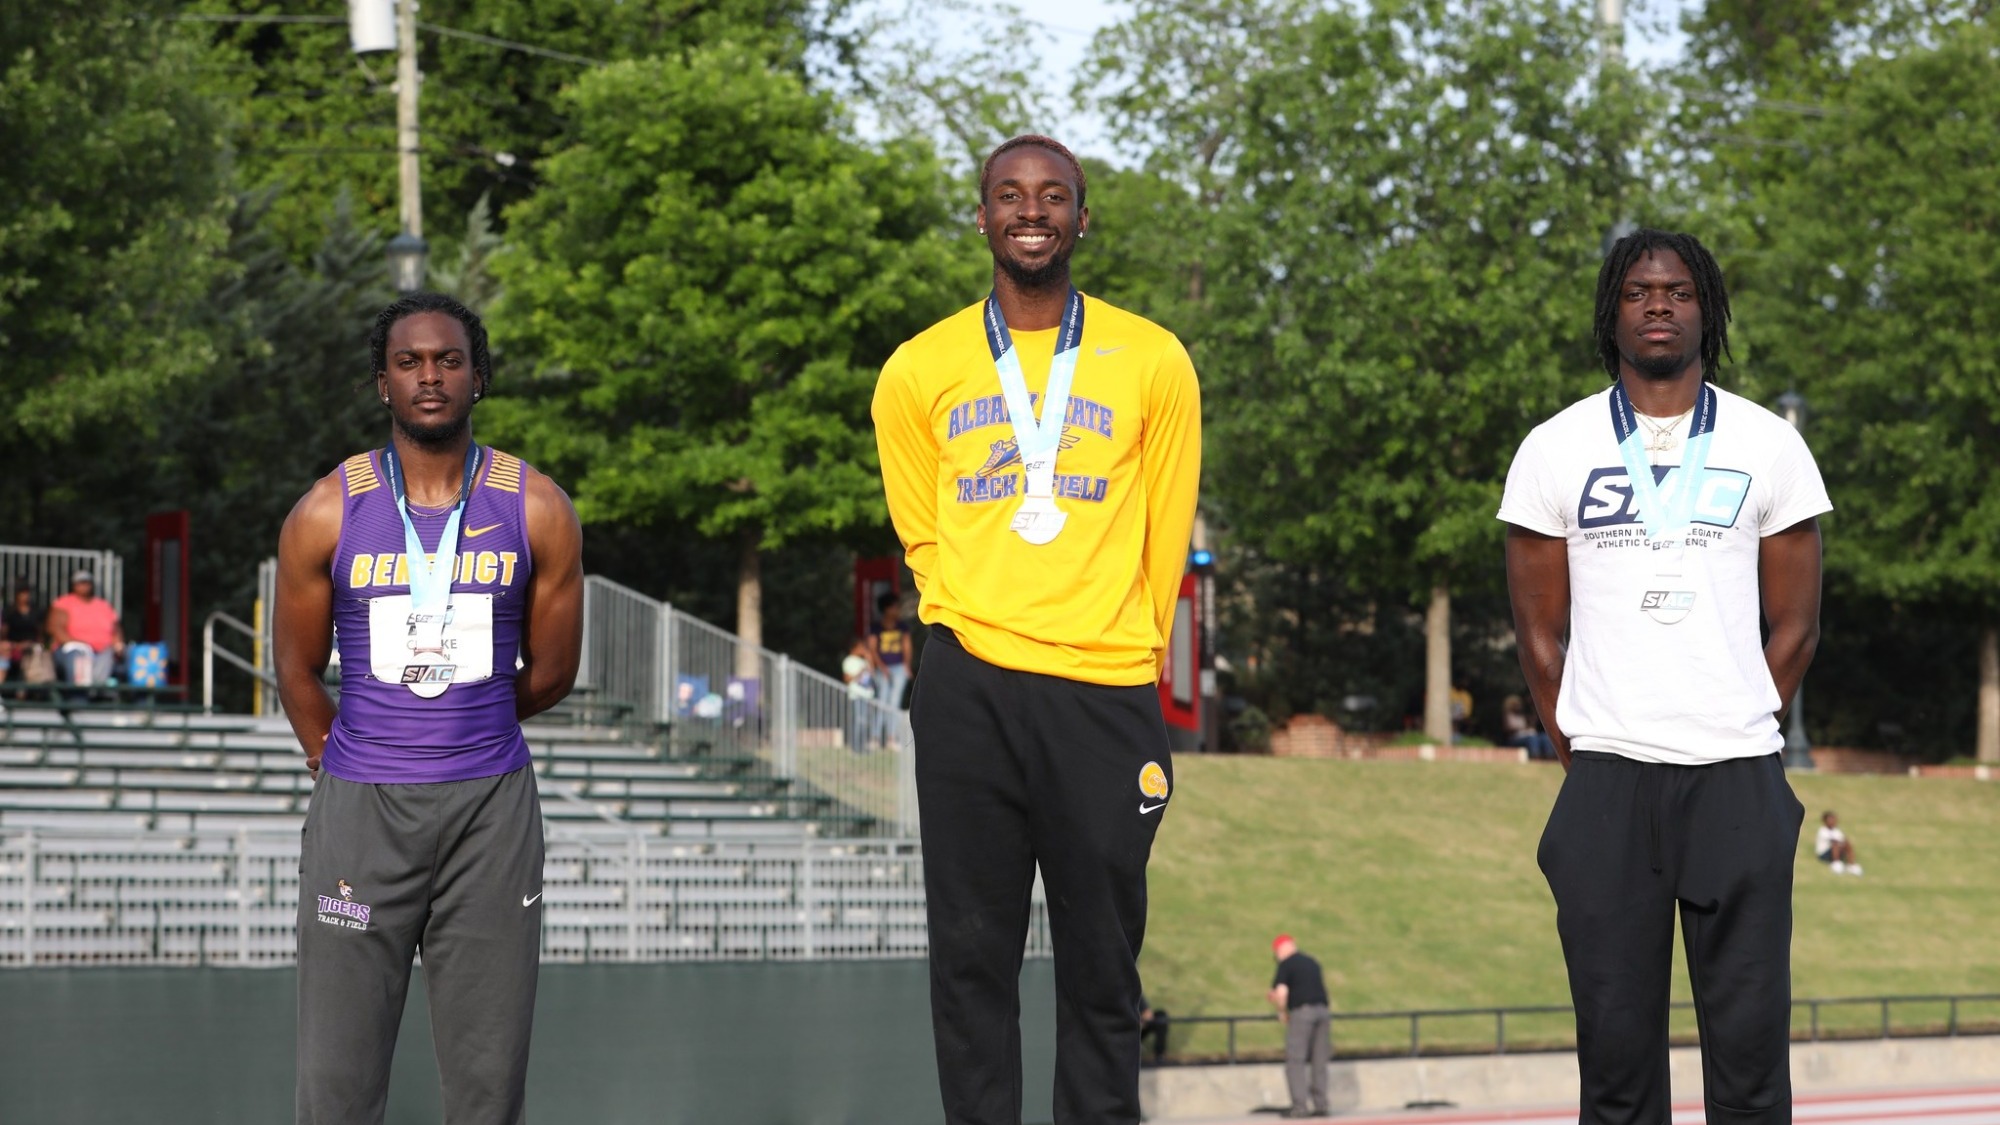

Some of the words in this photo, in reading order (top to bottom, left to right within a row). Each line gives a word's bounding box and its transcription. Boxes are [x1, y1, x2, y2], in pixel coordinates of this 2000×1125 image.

[948, 392, 1038, 441] ALBA
[956, 472, 1018, 503] TRACK
[1584, 529, 1632, 541] SOUTHERN
[1597, 539, 1640, 549] ATHLETIC
[401, 665, 456, 683] SIAC
[318, 895, 370, 923] TIGERS
[317, 914, 339, 925] TRACK
[346, 920, 367, 930] FIELD
